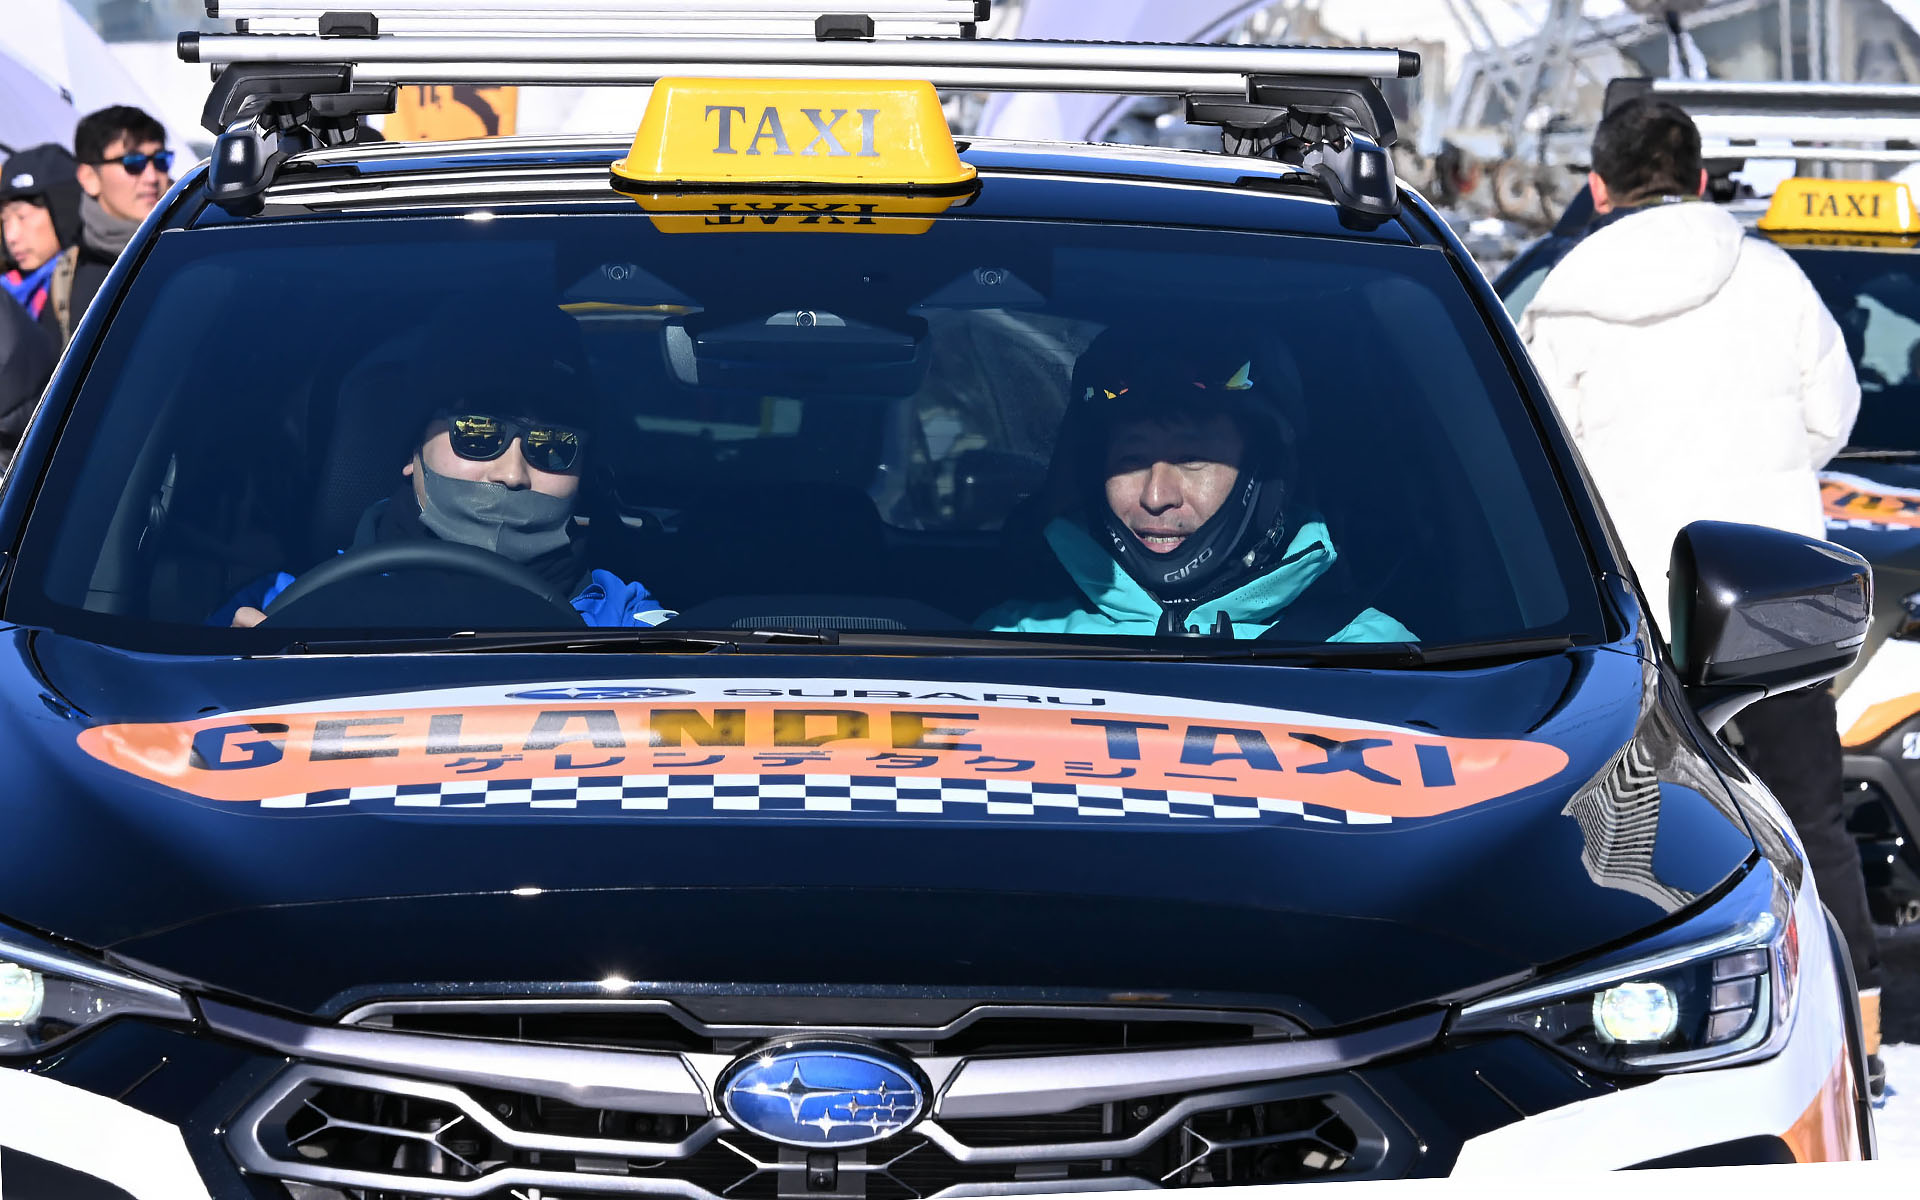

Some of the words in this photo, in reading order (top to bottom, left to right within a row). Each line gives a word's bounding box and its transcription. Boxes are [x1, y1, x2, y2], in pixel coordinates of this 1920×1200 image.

[704, 105, 881, 158] TAXI
[1799, 192, 1881, 219] TAXI
[1163, 547, 1213, 583] GIRO
[722, 688, 1107, 706] SUBARU
[188, 708, 983, 771] GELANDE
[1069, 717, 1457, 788] TAXI
[443, 750, 1238, 782] ゲレンデタクシー
